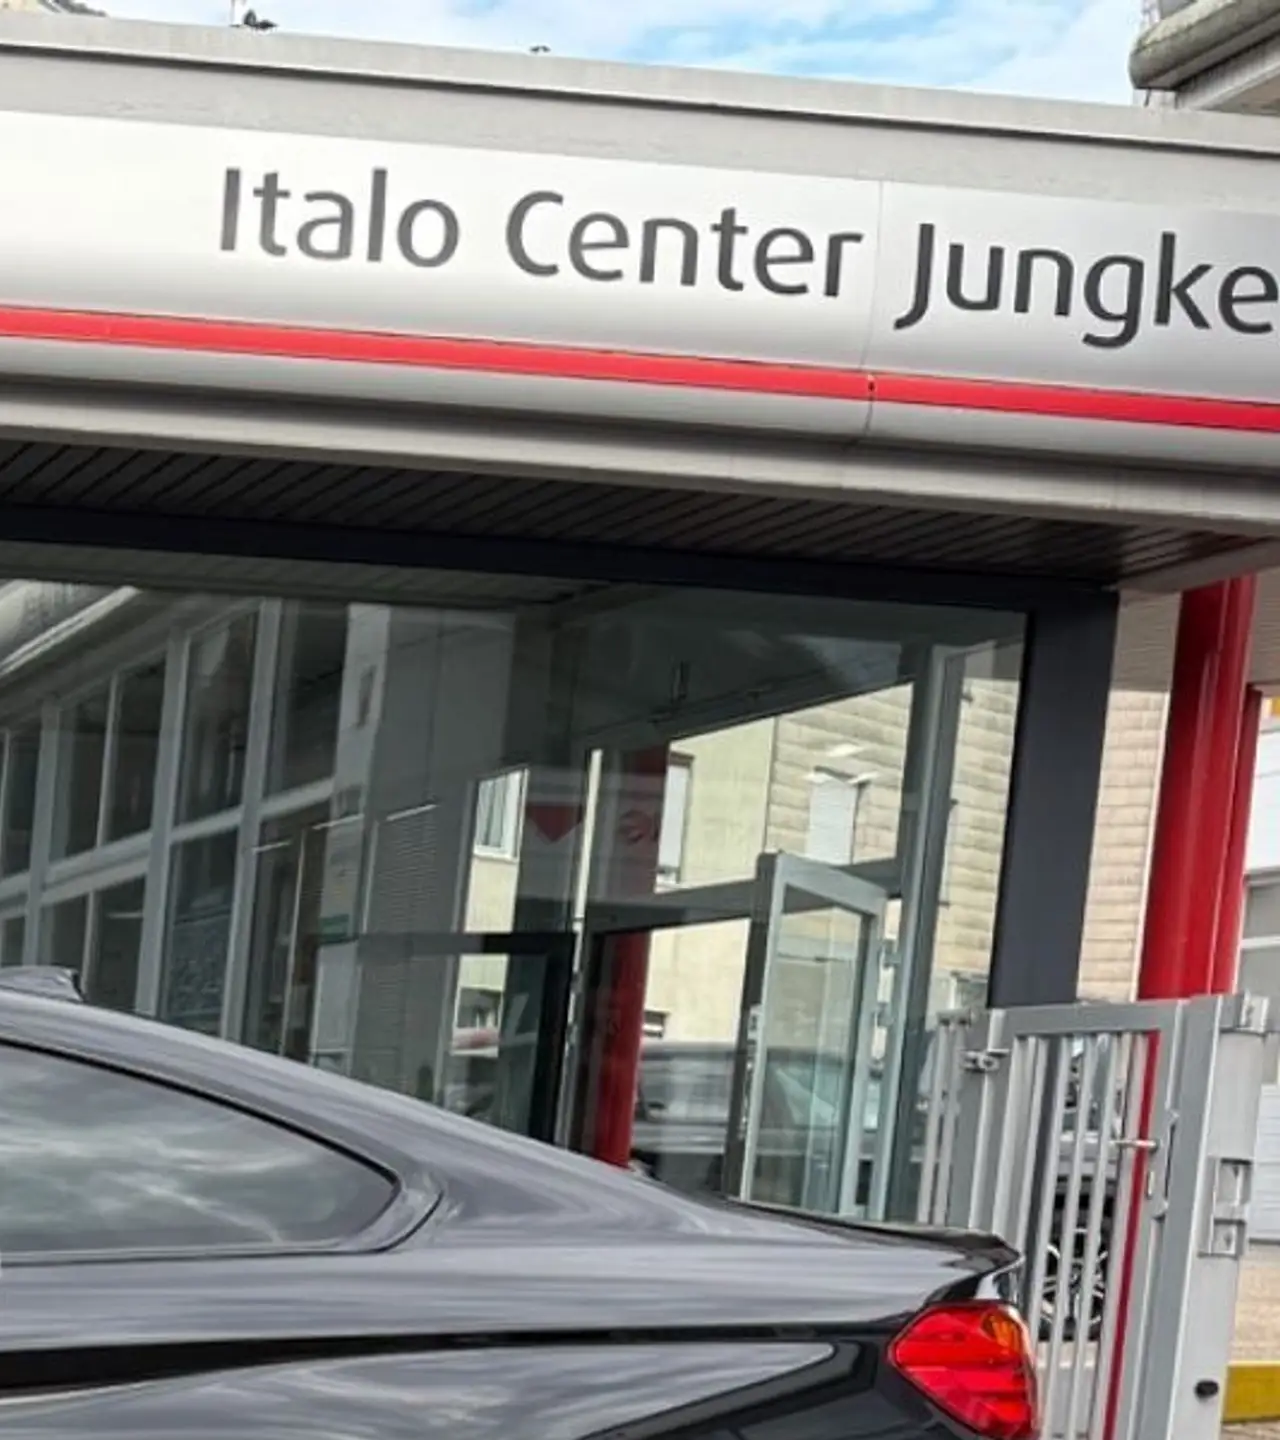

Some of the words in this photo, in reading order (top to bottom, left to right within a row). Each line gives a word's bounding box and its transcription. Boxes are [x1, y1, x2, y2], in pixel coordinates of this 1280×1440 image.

[220, 167, 459, 267] Italo
[506, 190, 863, 298] Center
[893, 222, 1280, 349] Jungke
